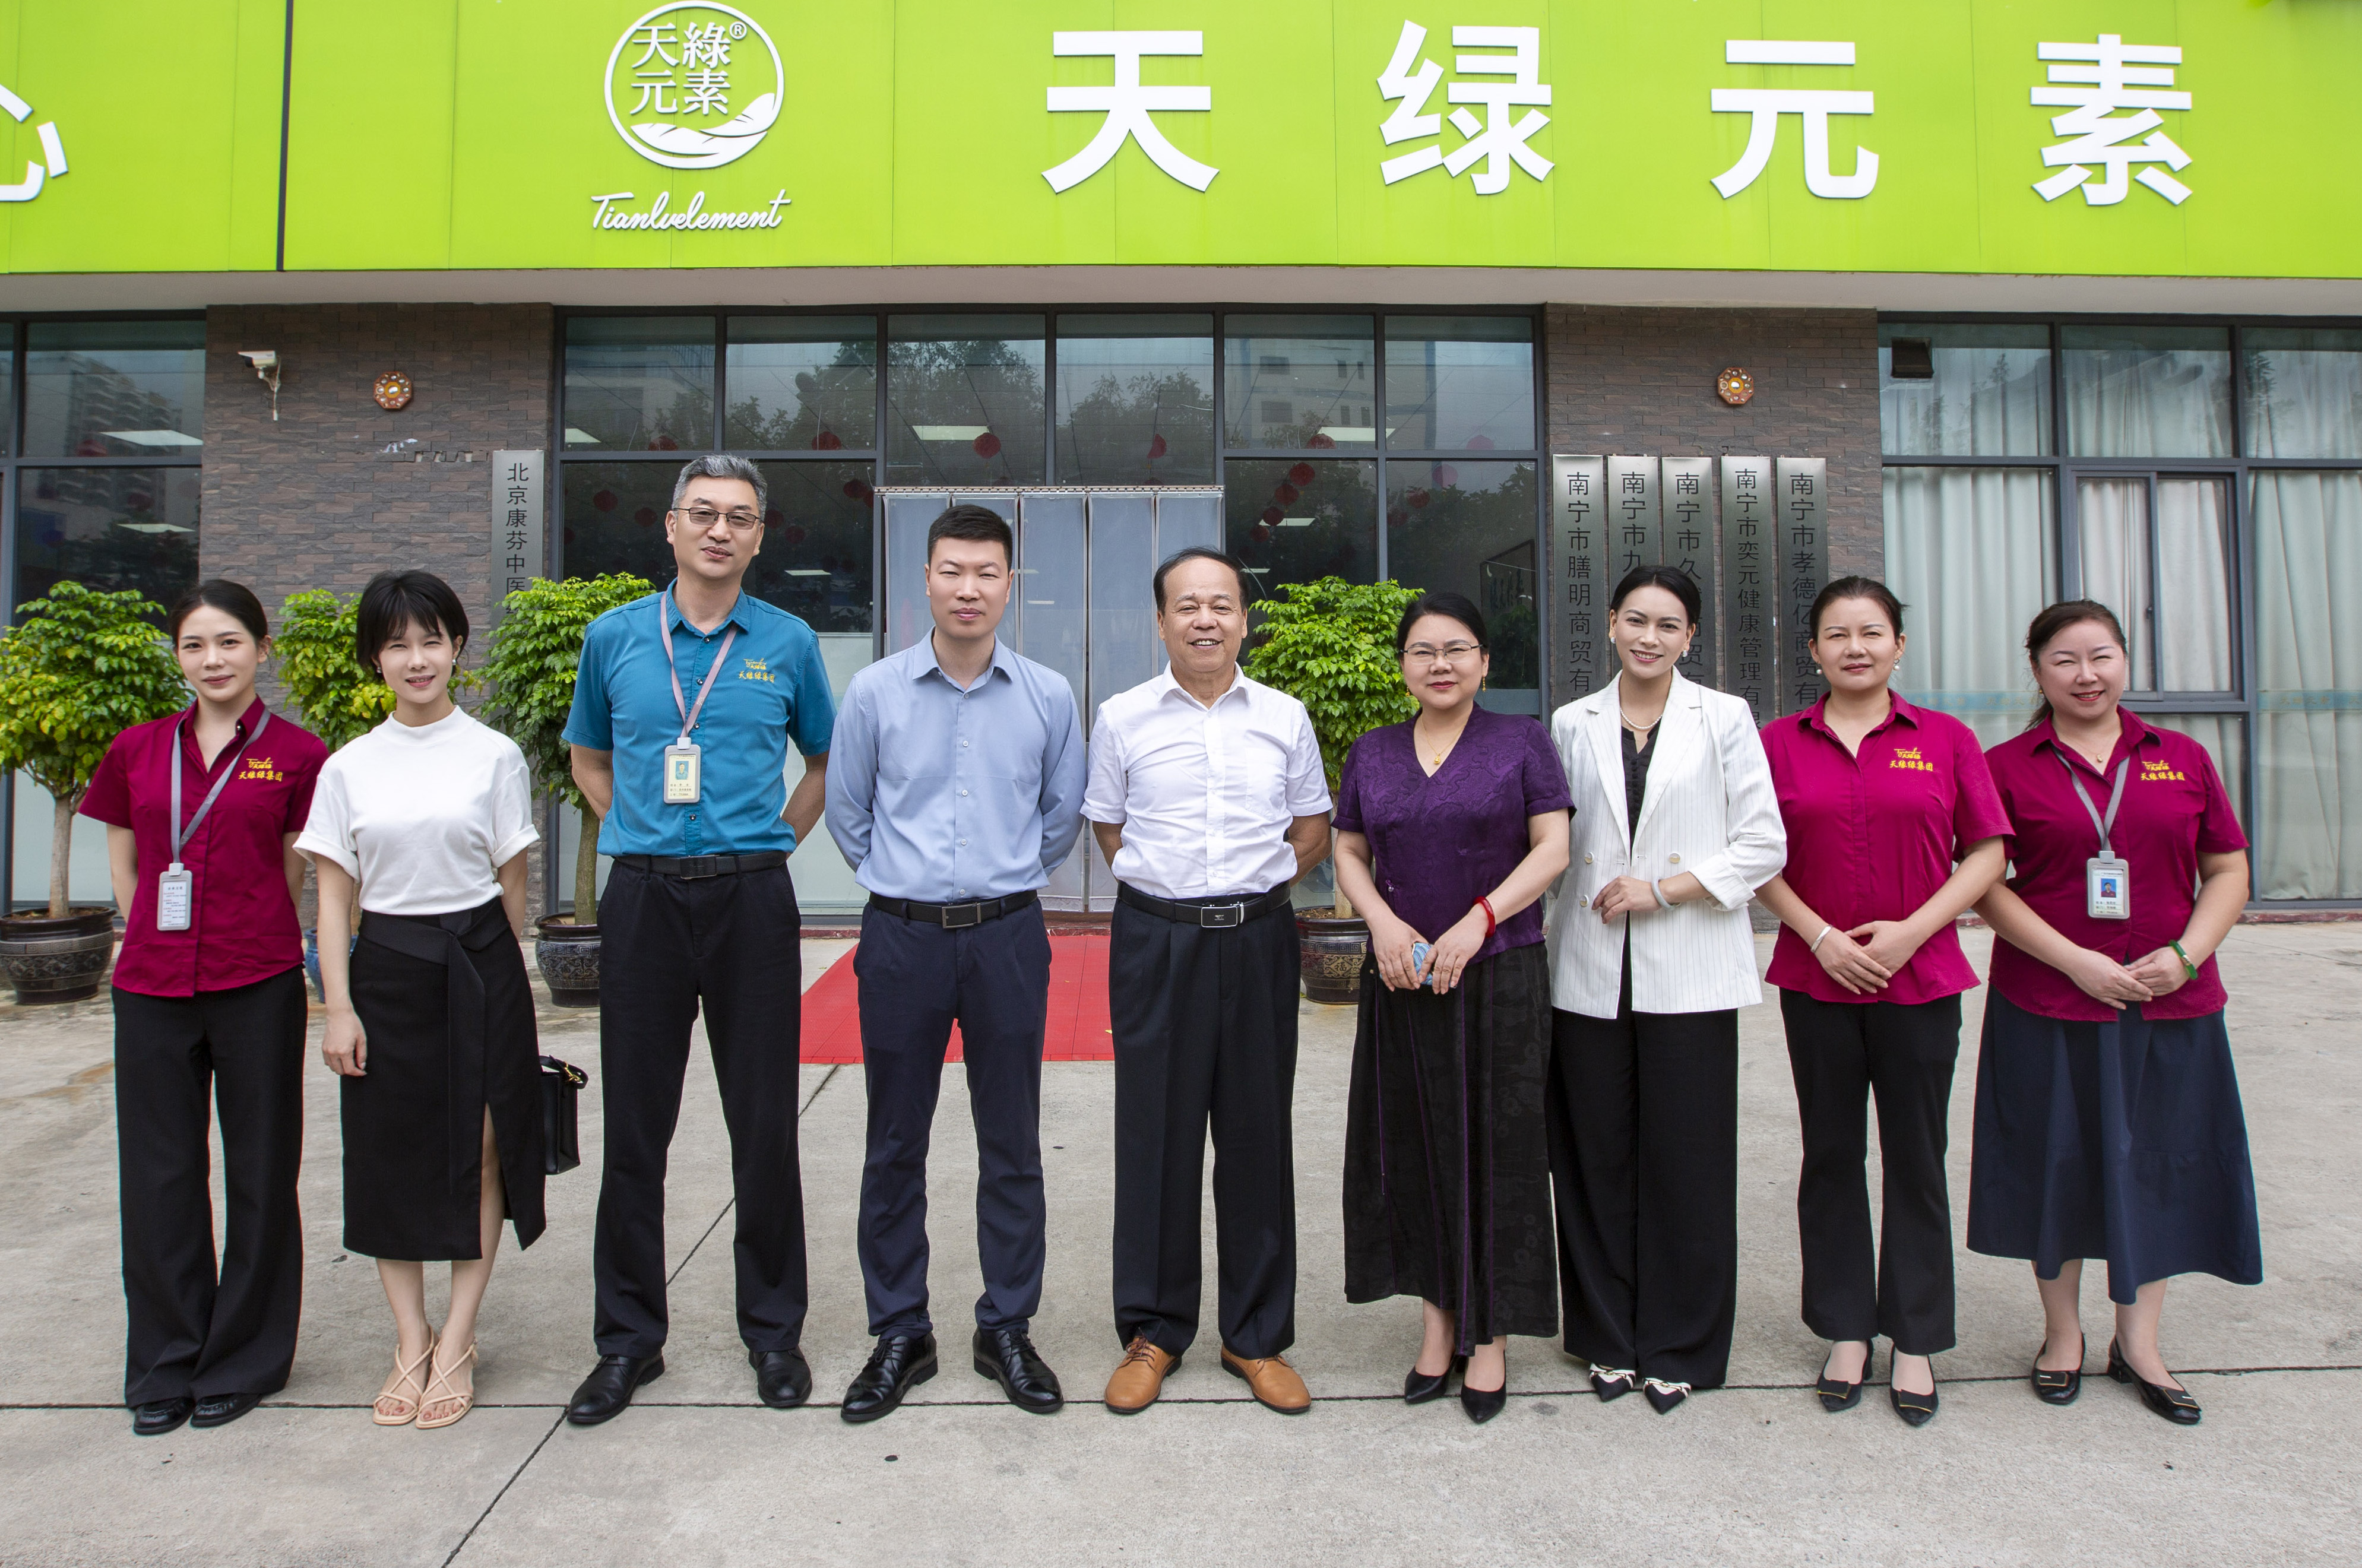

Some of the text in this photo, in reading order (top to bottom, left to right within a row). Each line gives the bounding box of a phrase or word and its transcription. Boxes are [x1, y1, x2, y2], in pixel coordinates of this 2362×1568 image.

[630, 68, 731, 115] 元素
[1041, 19, 2193, 206] 天绿元素
[505, 463, 529, 614] 北京康芬中医
[1566, 471, 1592, 703] 南宁市膳明商贸有
[1790, 473, 1821, 714] 南宁市孝德亿商贸有
